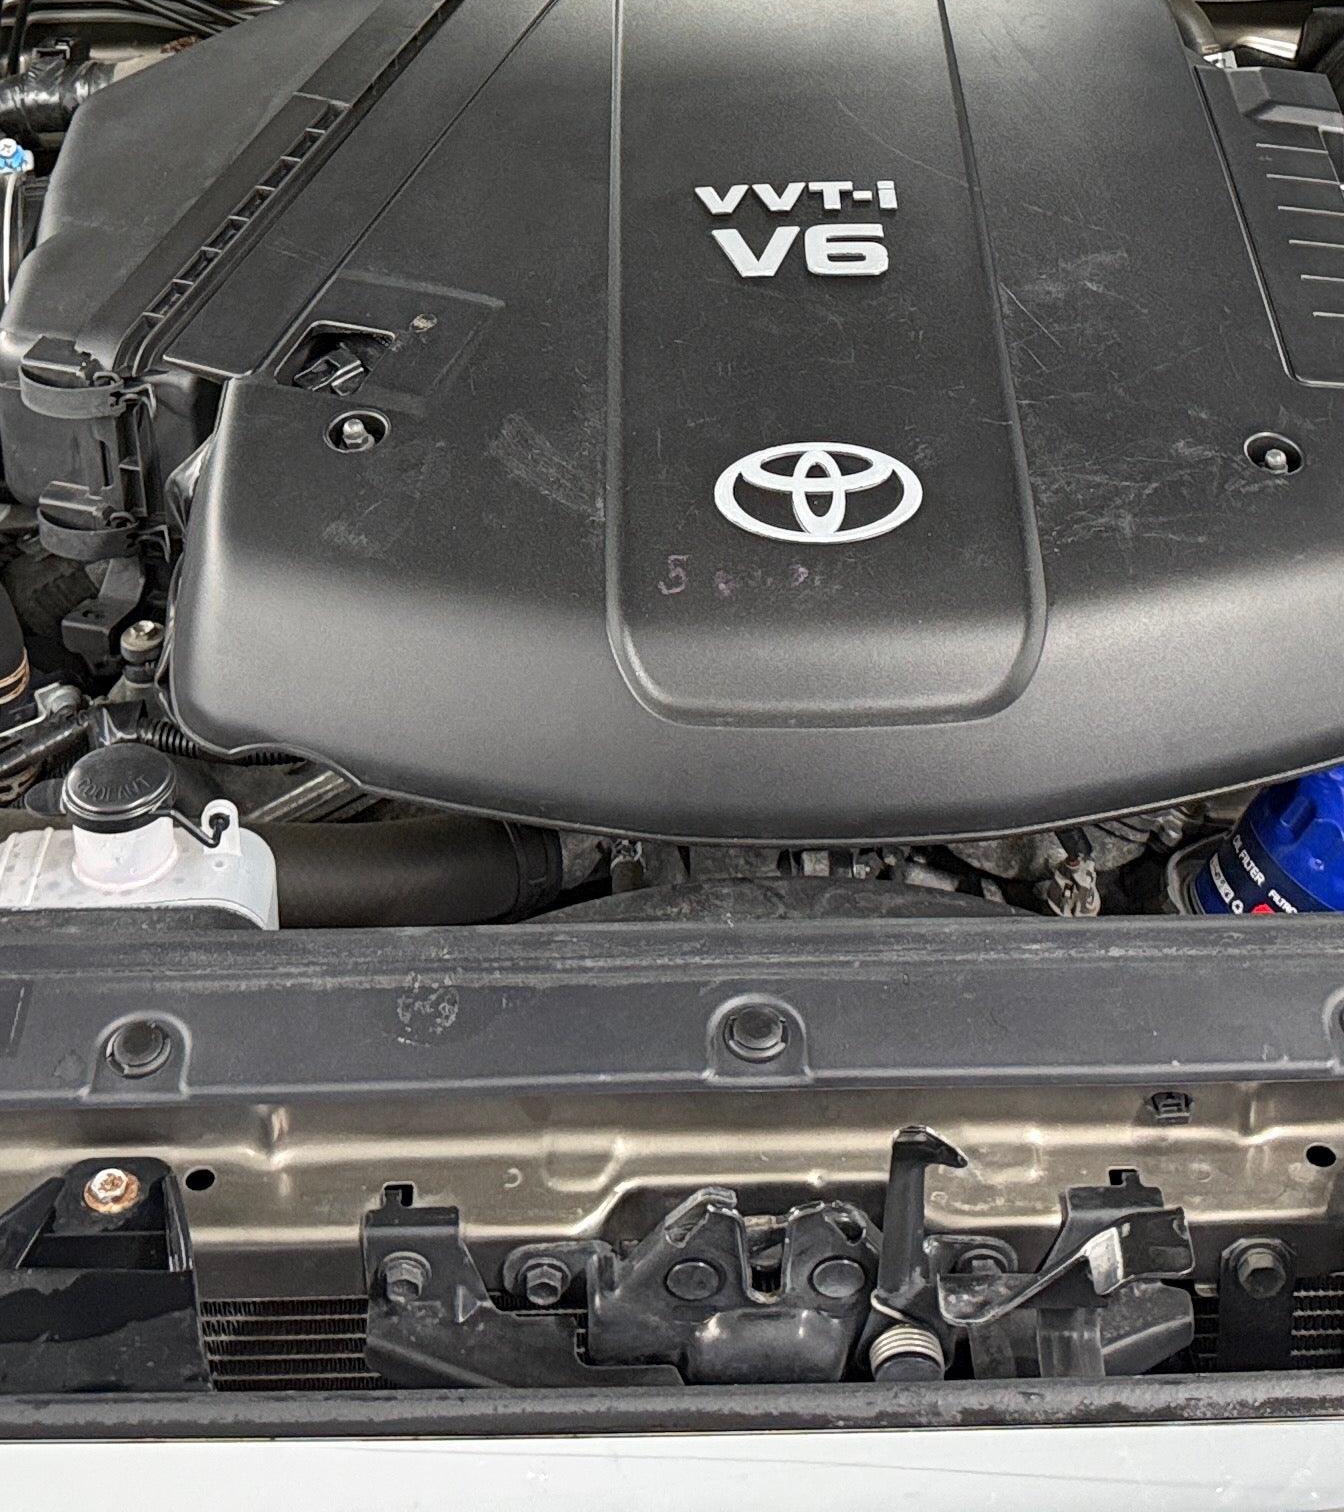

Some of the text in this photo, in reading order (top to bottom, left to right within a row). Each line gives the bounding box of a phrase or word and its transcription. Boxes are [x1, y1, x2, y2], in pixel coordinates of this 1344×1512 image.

[694, 180, 898, 215] VVT-i
[711, 223, 889, 278] V6
[1239, 849, 1265, 887] FILTER
